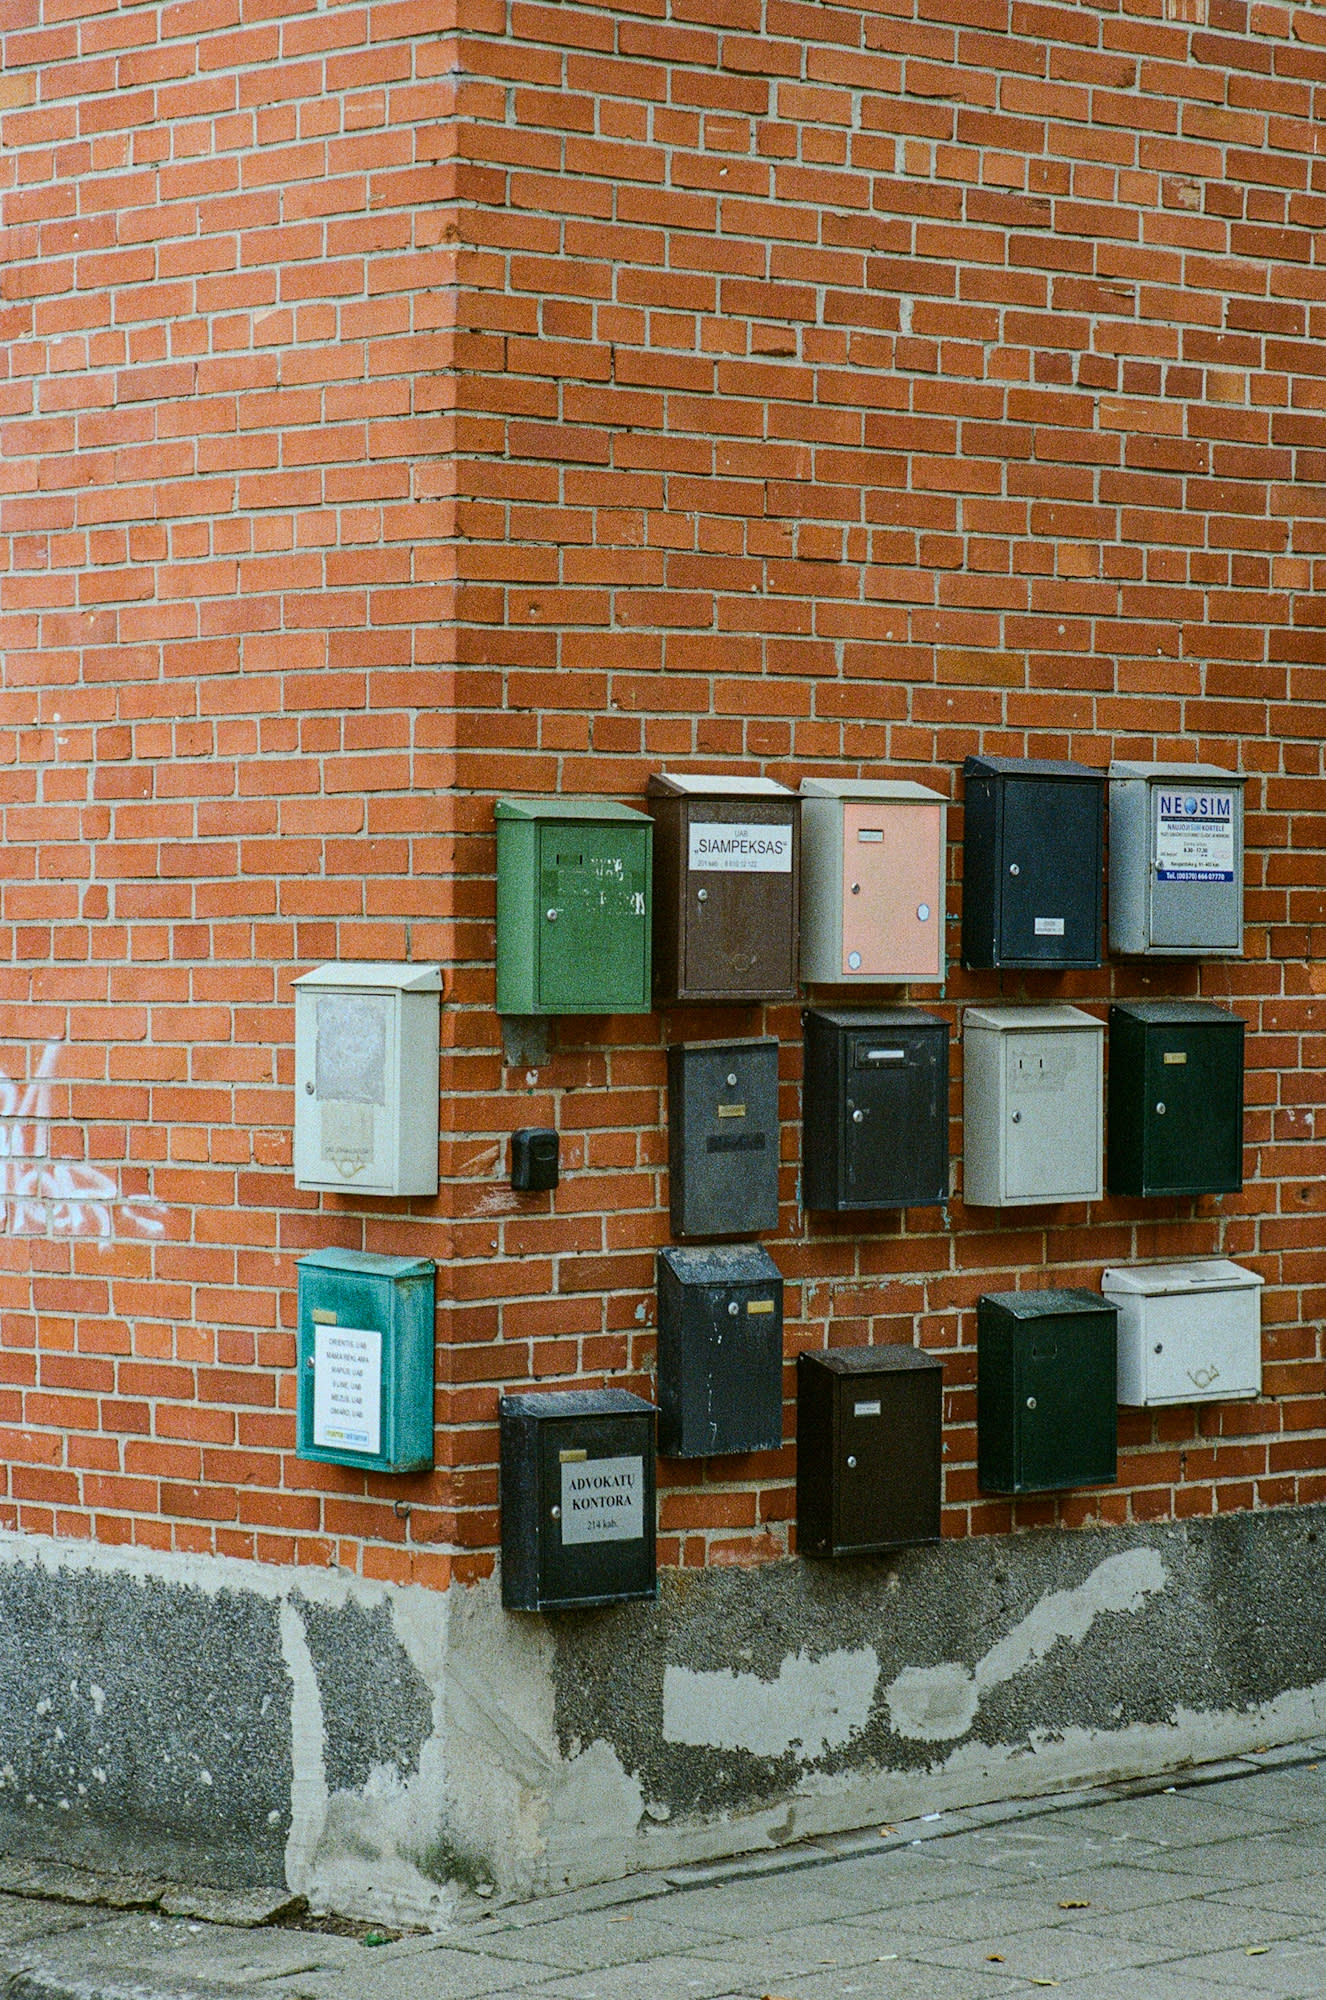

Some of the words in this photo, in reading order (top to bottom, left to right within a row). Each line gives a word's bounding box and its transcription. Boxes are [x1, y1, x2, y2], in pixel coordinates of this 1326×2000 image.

[1160, 796, 1231, 815] NEOSIM
[569, 1474, 635, 1491] ADVOKATŲ
[572, 1494, 632, 1511] KONTORA
